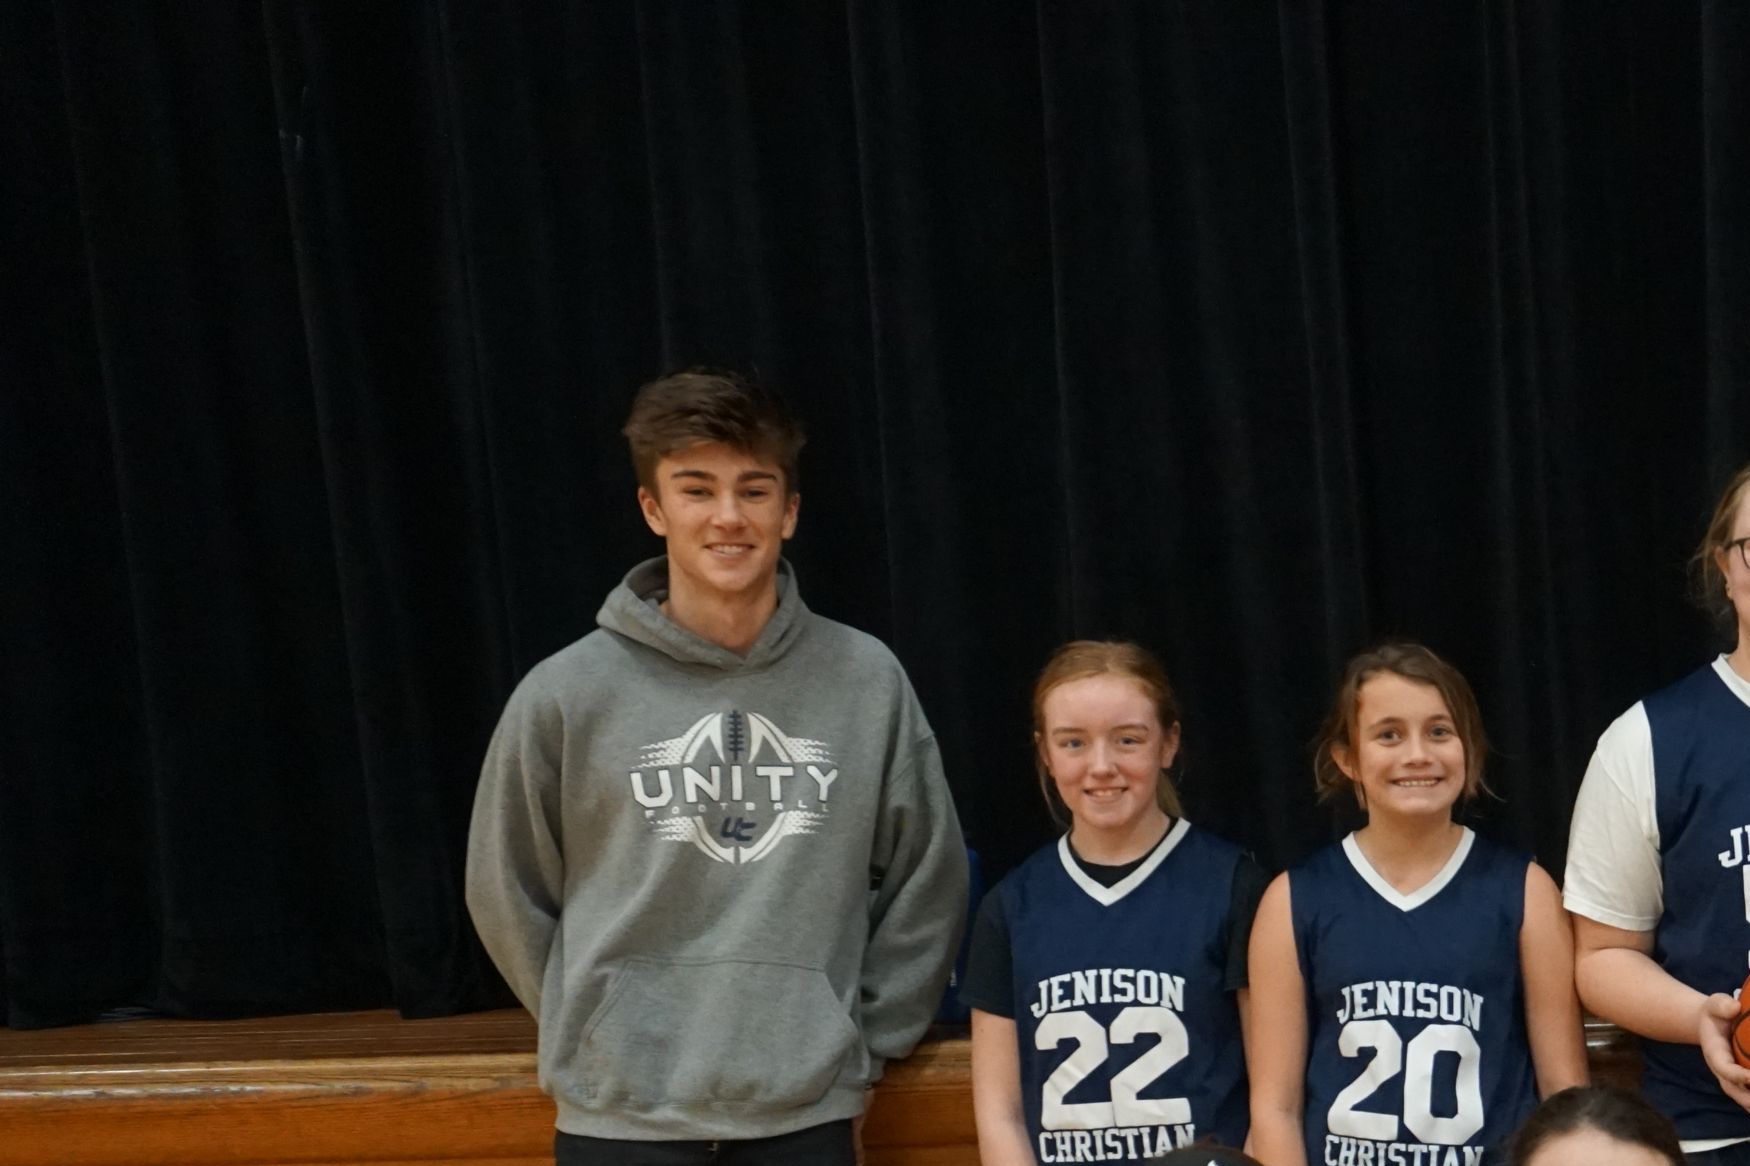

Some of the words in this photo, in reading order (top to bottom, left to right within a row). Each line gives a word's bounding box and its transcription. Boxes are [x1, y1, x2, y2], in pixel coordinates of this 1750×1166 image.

[629, 765, 838, 808] UNITY
[645, 799, 829, 818] FOOTBALL
[1030, 968, 1186, 1019] JENISON
[1336, 980, 1484, 1032] JENISON
[1034, 1006, 1192, 1130] 22
[1327, 1019, 1484, 1145] 20
[1038, 1124, 1196, 1163] CHRISTIAN
